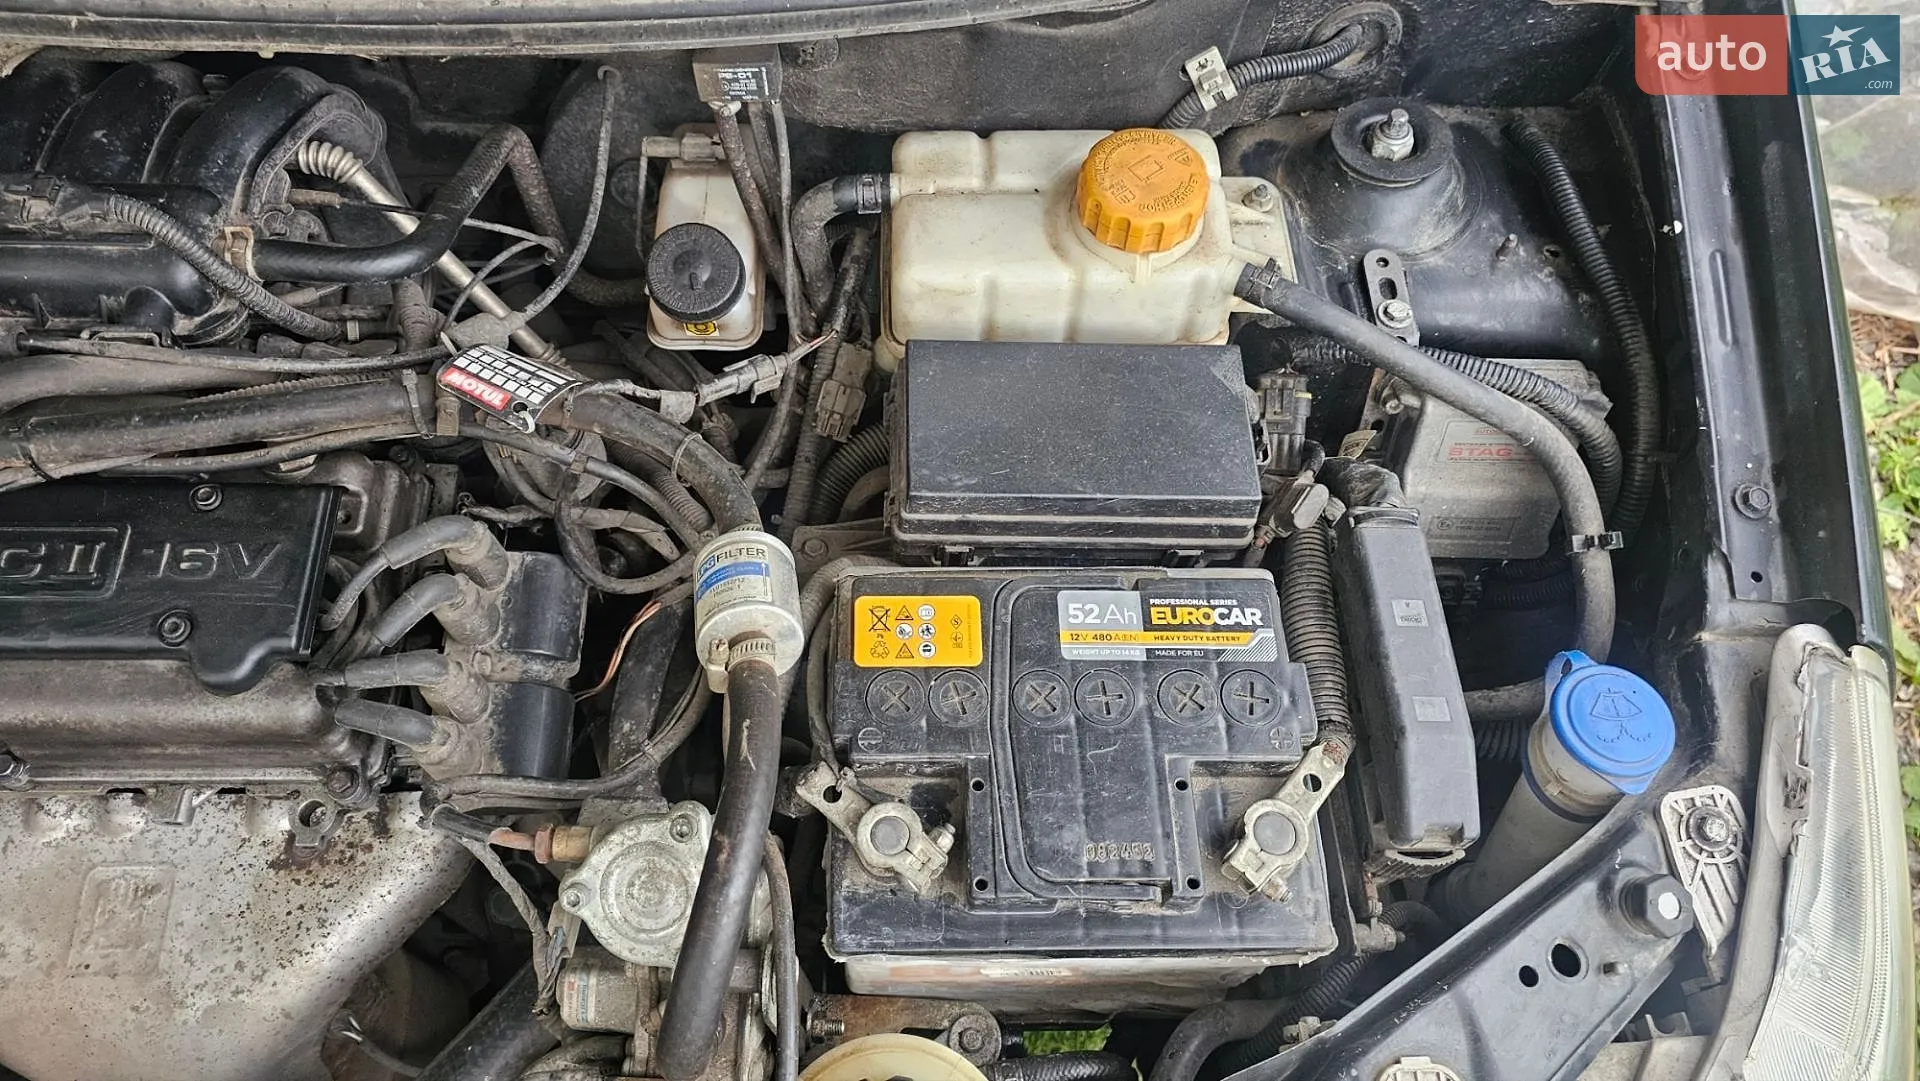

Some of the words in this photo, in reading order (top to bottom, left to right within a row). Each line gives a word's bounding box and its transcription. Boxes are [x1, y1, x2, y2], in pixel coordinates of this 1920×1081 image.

[445, 371, 505, 406] MOTUL
[1449, 447, 1512, 457] STAG
[143, 543, 282, 579] 16V
[717, 547, 766, 562] FILTER
[1068, 603, 1101, 624] 52
[1103, 603, 1137, 625] Ah
[1151, 607, 1264, 626] EUROCAR
[1070, 633, 1088, 641] 12V
